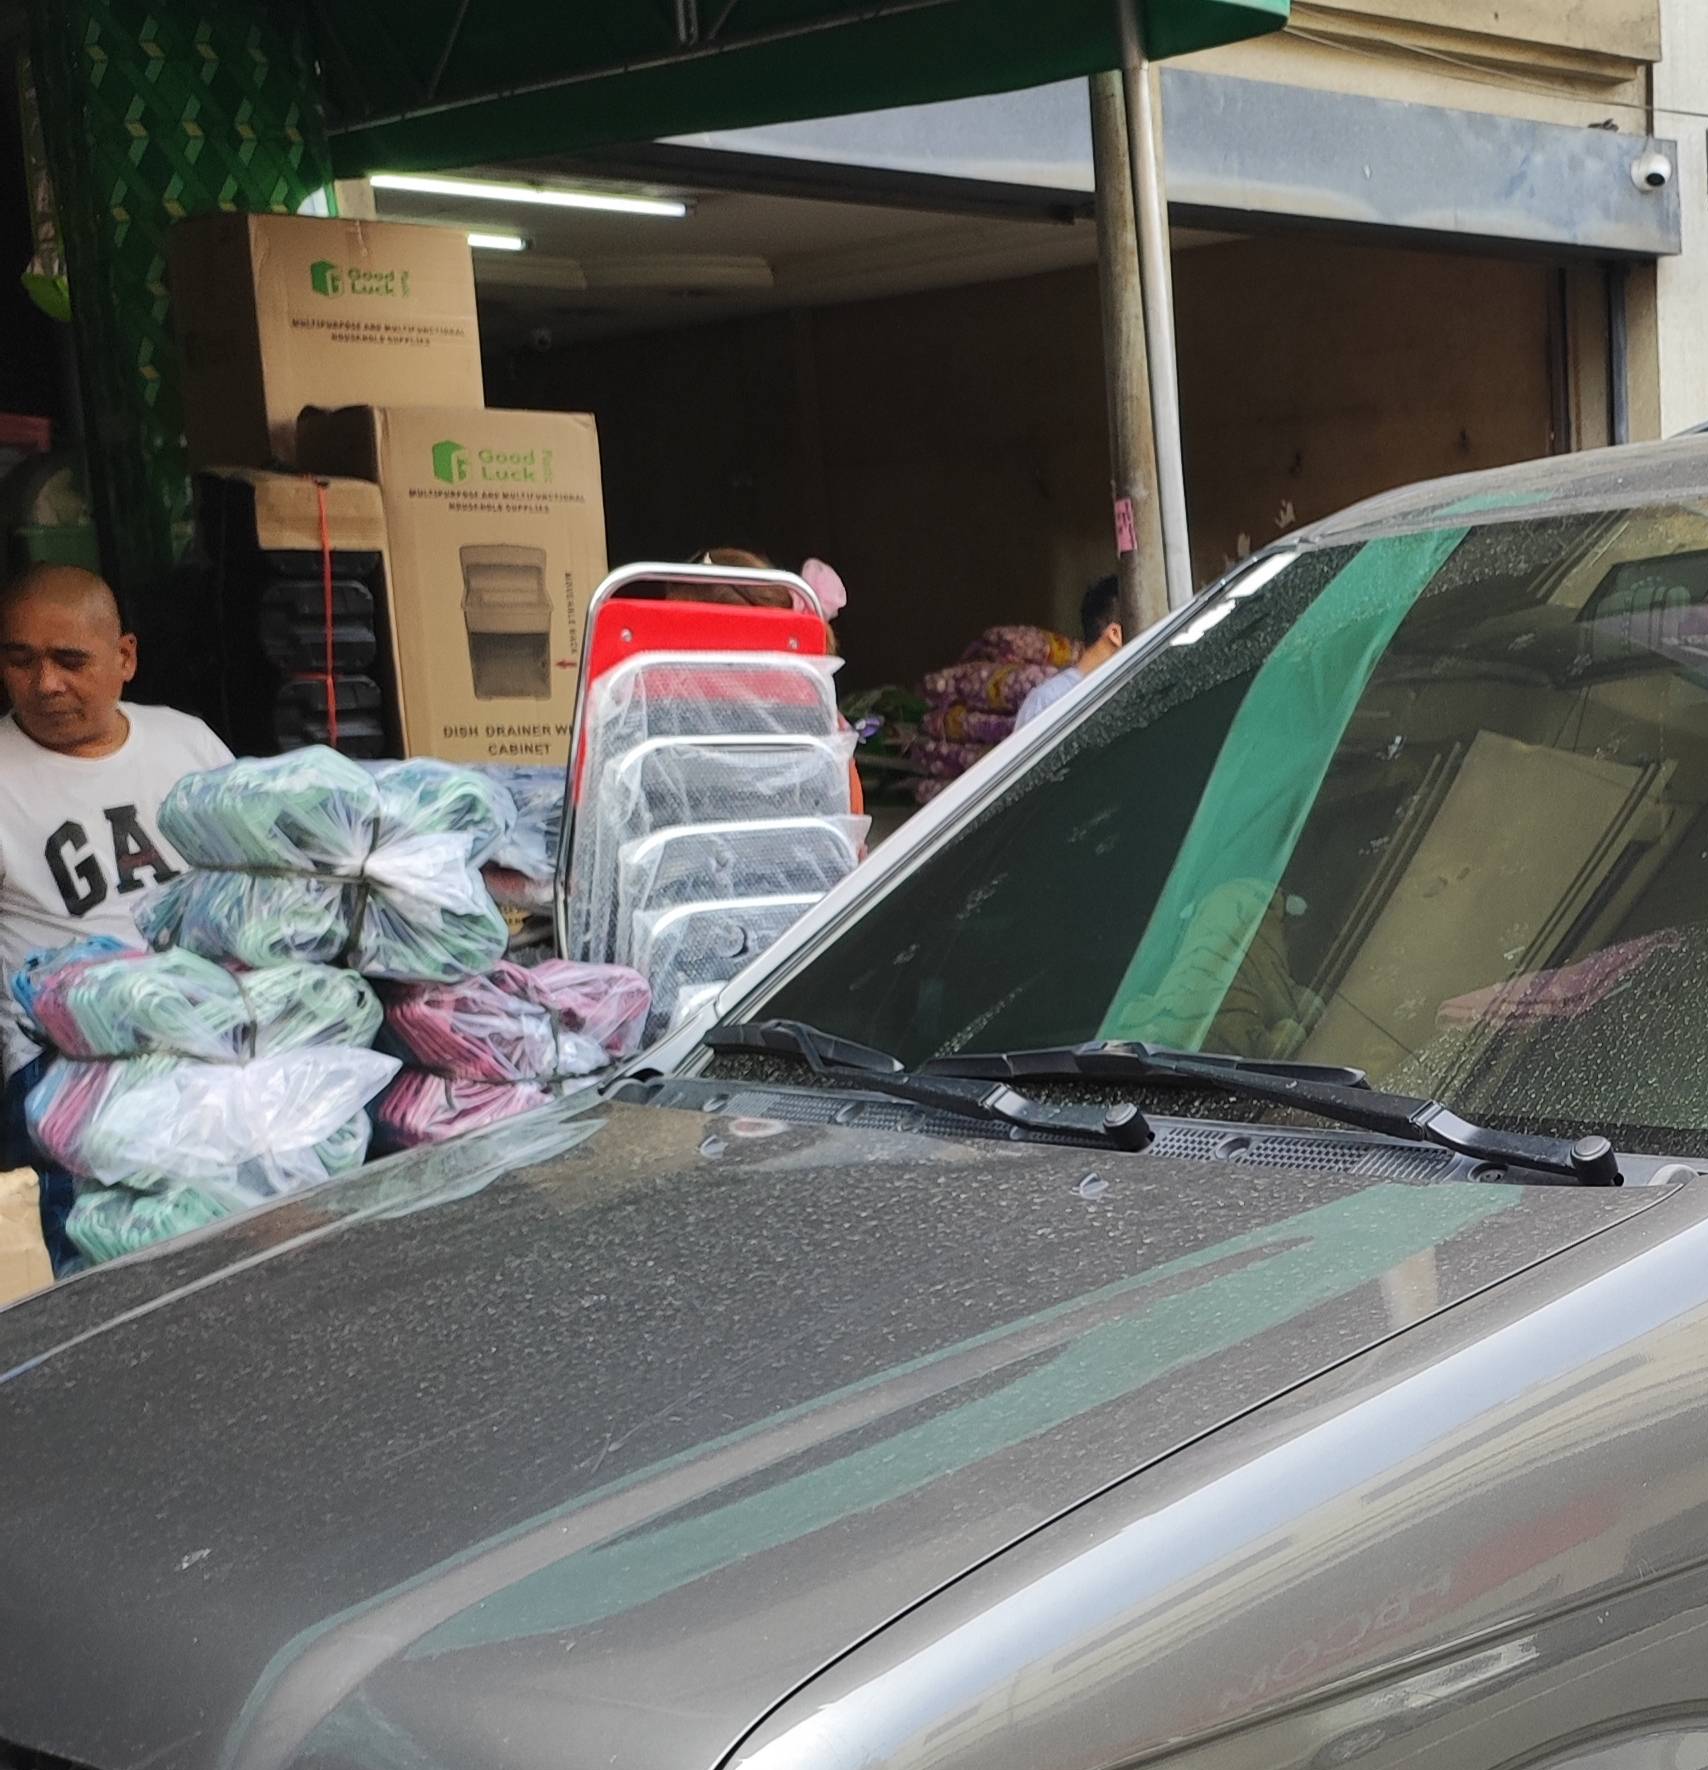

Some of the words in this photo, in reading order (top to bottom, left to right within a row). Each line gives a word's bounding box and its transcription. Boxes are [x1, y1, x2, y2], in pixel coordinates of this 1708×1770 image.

[347, 268, 394, 281] Good
[351, 281, 394, 296] Luck
[478, 449, 535, 465] Good
[481, 466, 534, 481] Luck
[443, 725, 479, 738] DISH
[485, 724, 553, 737] DRAINER
[488, 743, 551, 756] CABINET
[45, 804, 181, 915] GA
